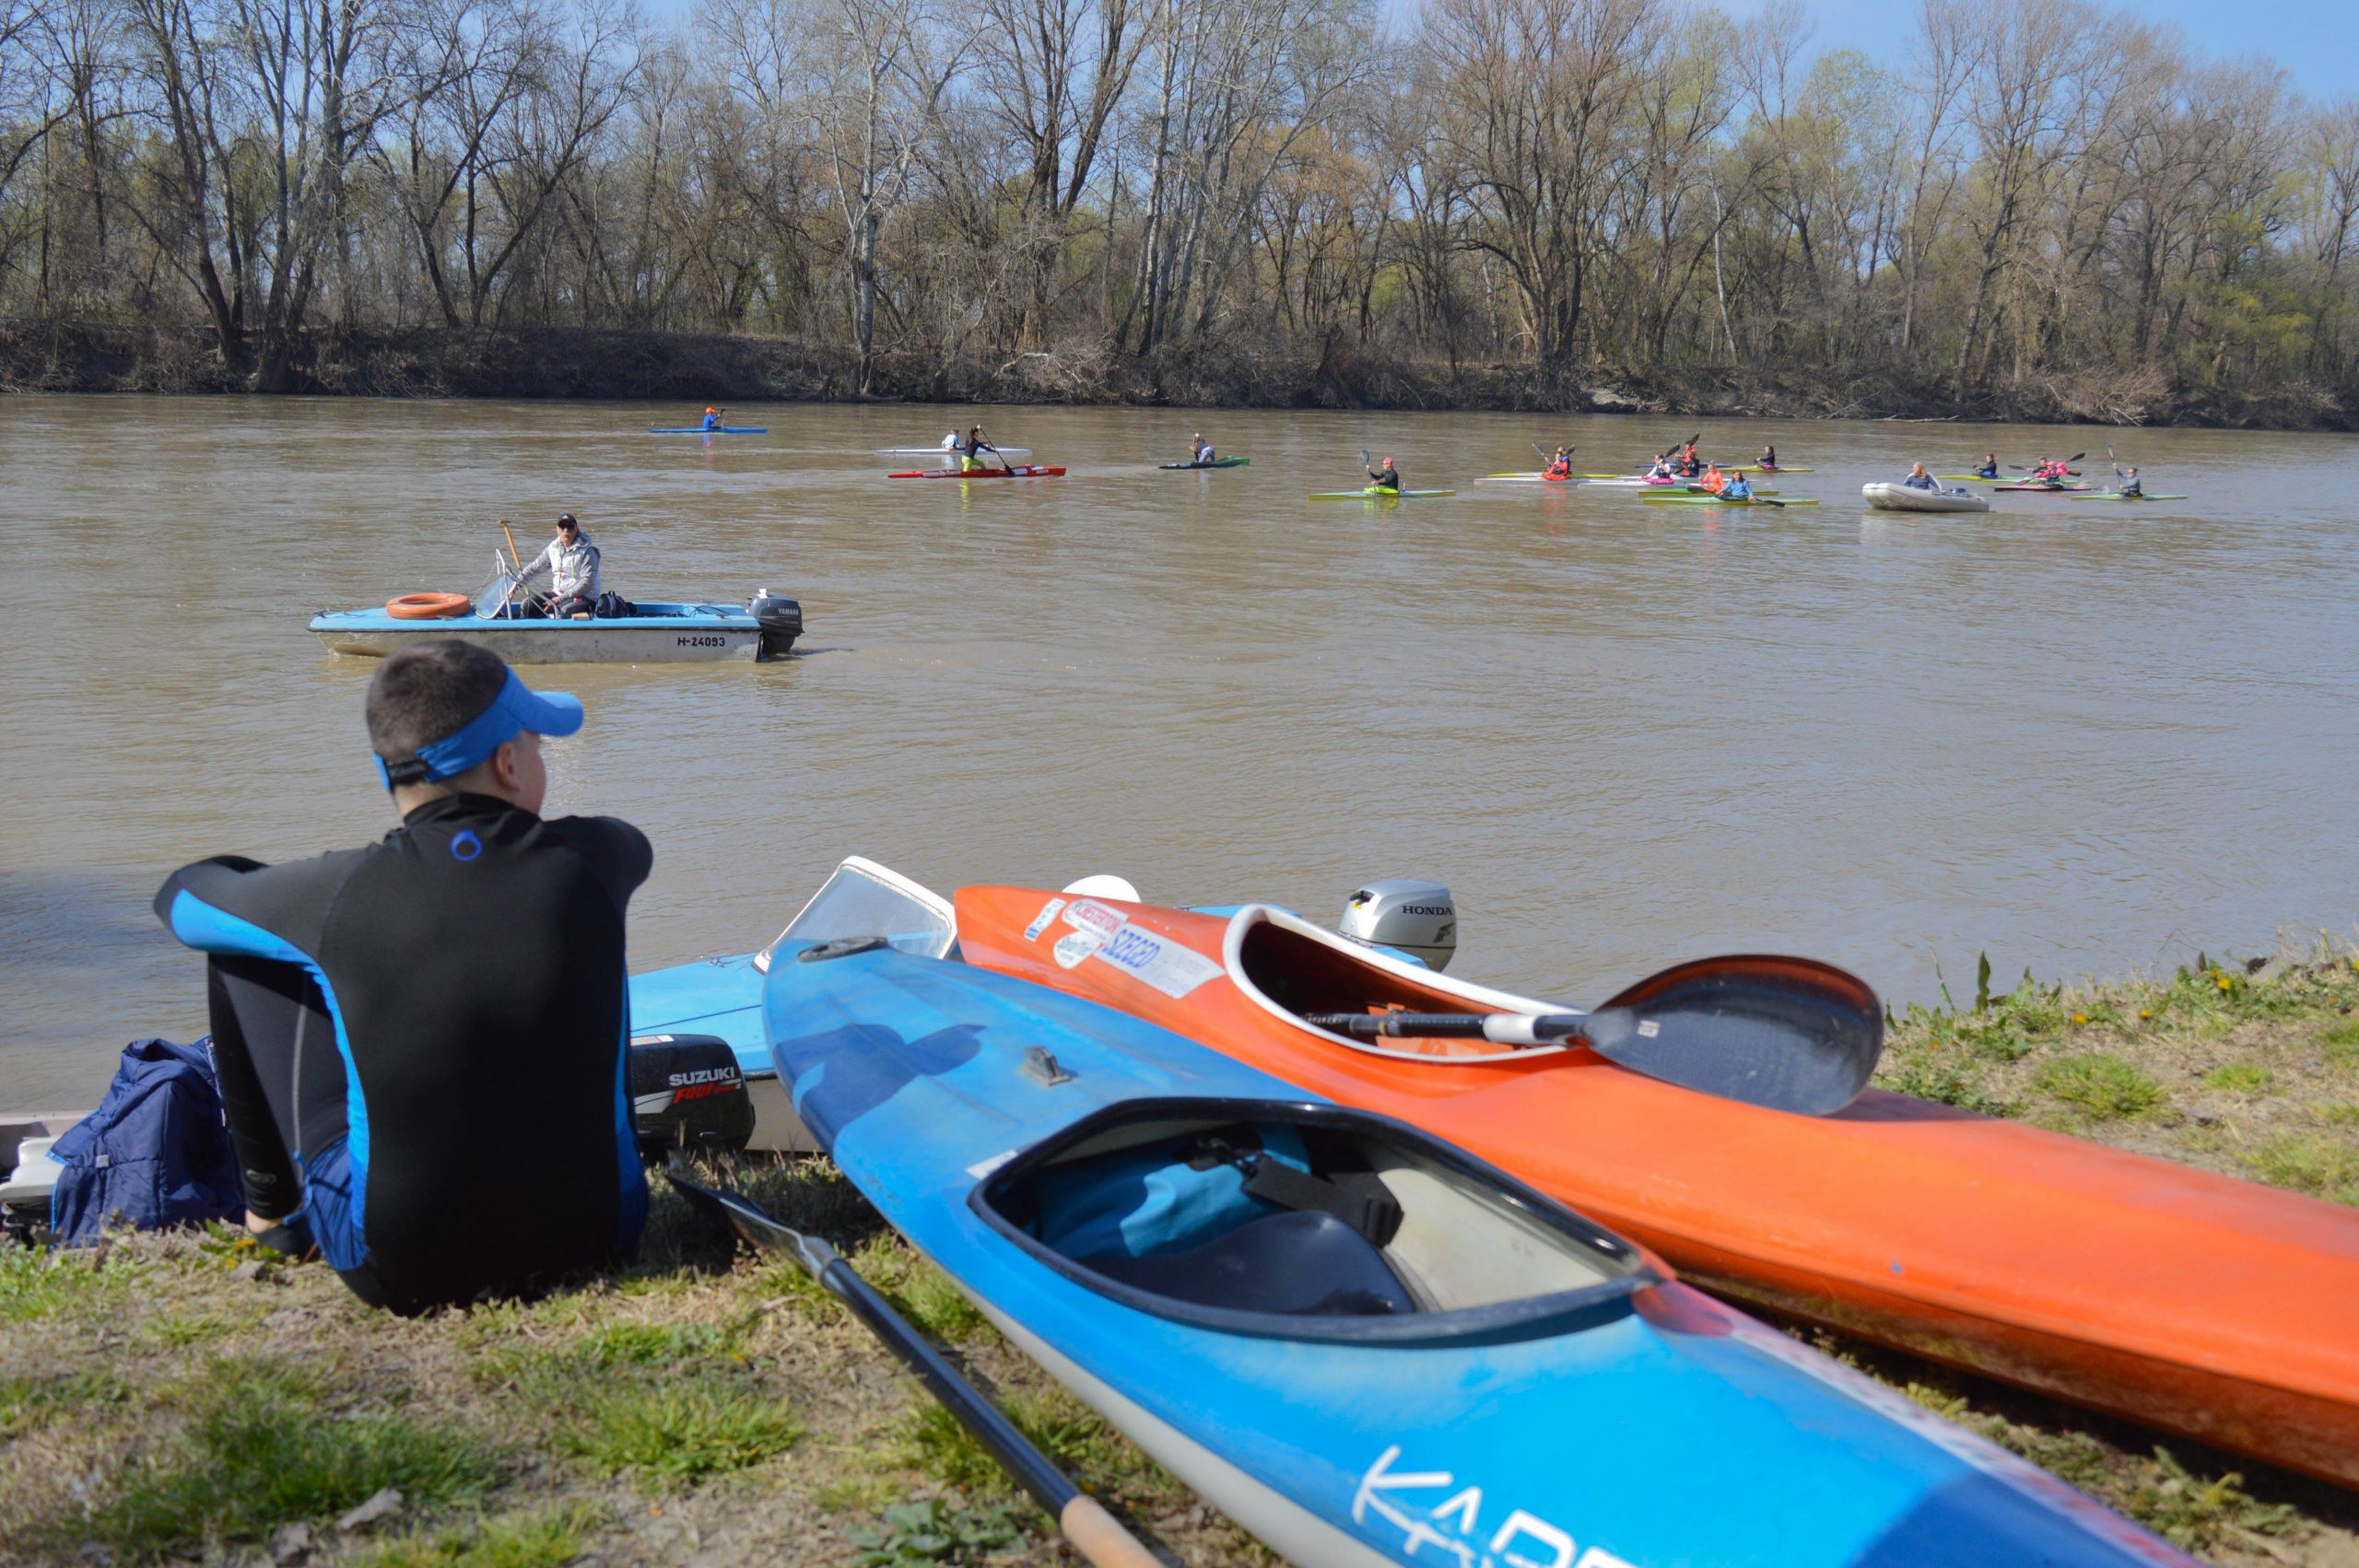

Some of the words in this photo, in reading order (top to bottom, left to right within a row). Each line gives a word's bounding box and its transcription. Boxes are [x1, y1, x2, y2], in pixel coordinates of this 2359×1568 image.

[778, 607, 799, 615] YAMAHA
[677, 637, 725, 647] H-24093
[1402, 906, 1452, 915] HONDA
[1102, 929, 1161, 968] SZEGED
[669, 1067, 735, 1087] SUZUKI
